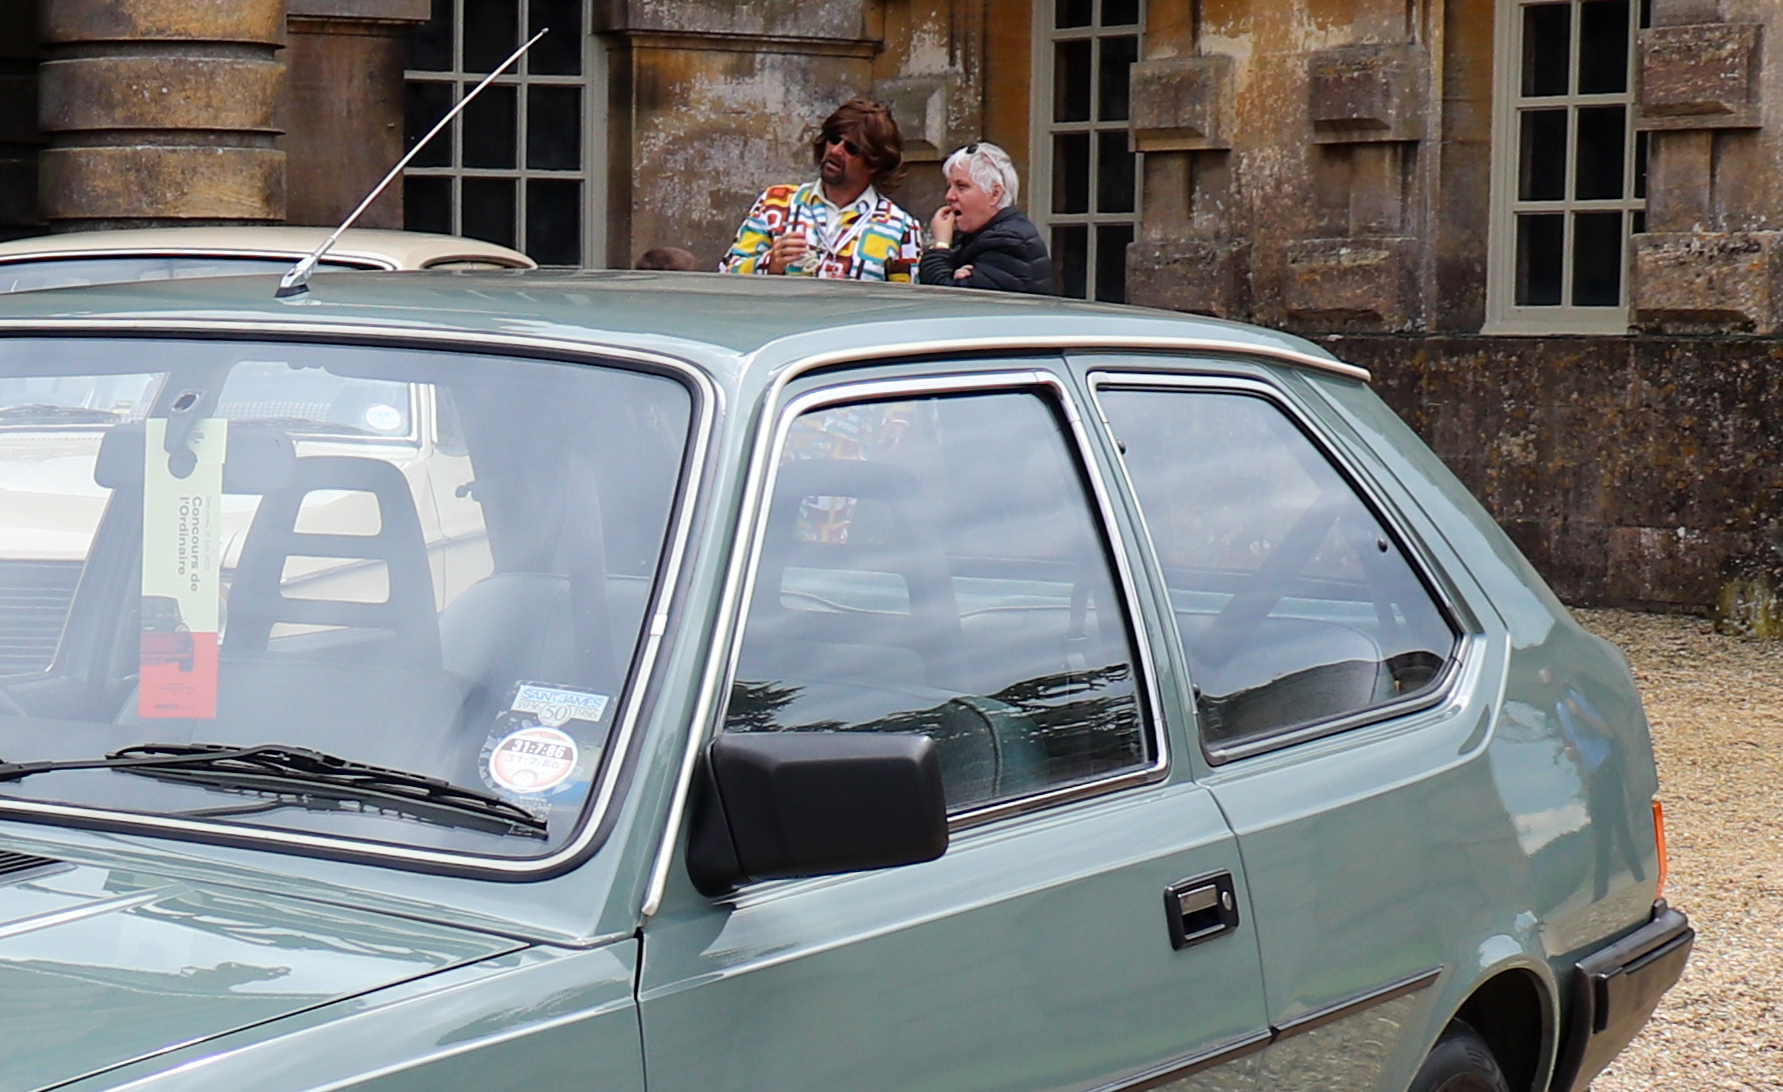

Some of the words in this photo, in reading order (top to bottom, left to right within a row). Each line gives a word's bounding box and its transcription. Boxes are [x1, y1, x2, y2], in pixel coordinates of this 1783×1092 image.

[177, 496, 190, 576] l'Ordinaire
[190, 496, 203, 570] Concours
[189, 572, 201, 592] de
[558, 693, 604, 709] JAMES
[543, 703, 568, 721] 50
[573, 706, 600, 720] 1986
[510, 739, 567, 759] 31:7:86
